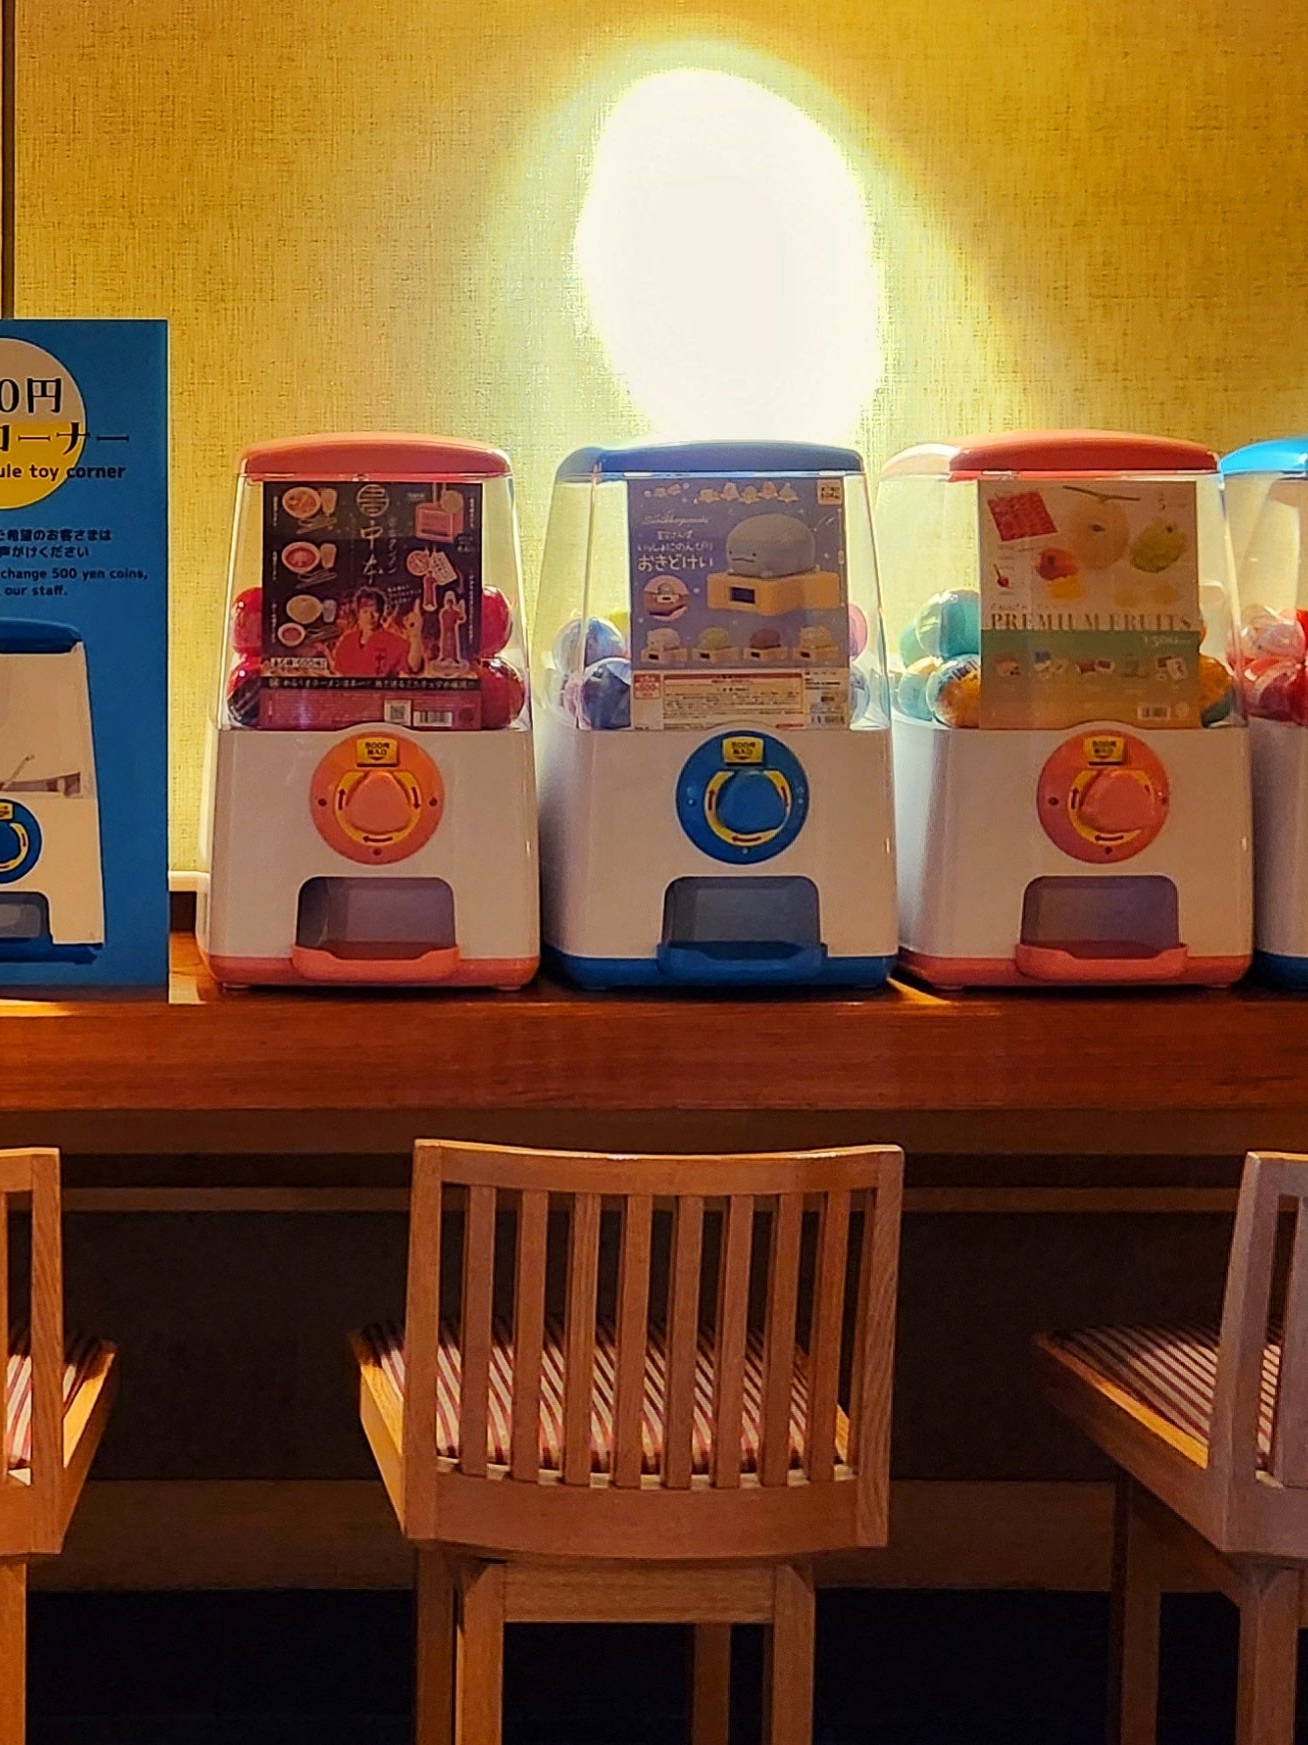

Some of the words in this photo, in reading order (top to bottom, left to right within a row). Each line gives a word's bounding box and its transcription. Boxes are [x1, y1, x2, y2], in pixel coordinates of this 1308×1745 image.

[29, 464, 60, 482] toy
[66, 465, 126, 479] corner
[637, 553, 714, 572] おきどけい
[51, 568, 77, 579] 500
[82, 571, 105, 582] yen
[109, 568, 149, 580] coins,
[4, 586, 27, 596] our
[32, 584, 69, 596] staff.
[991, 612, 1101, 631] PREMIUM
[1108, 612, 1193, 631] FRUITS
